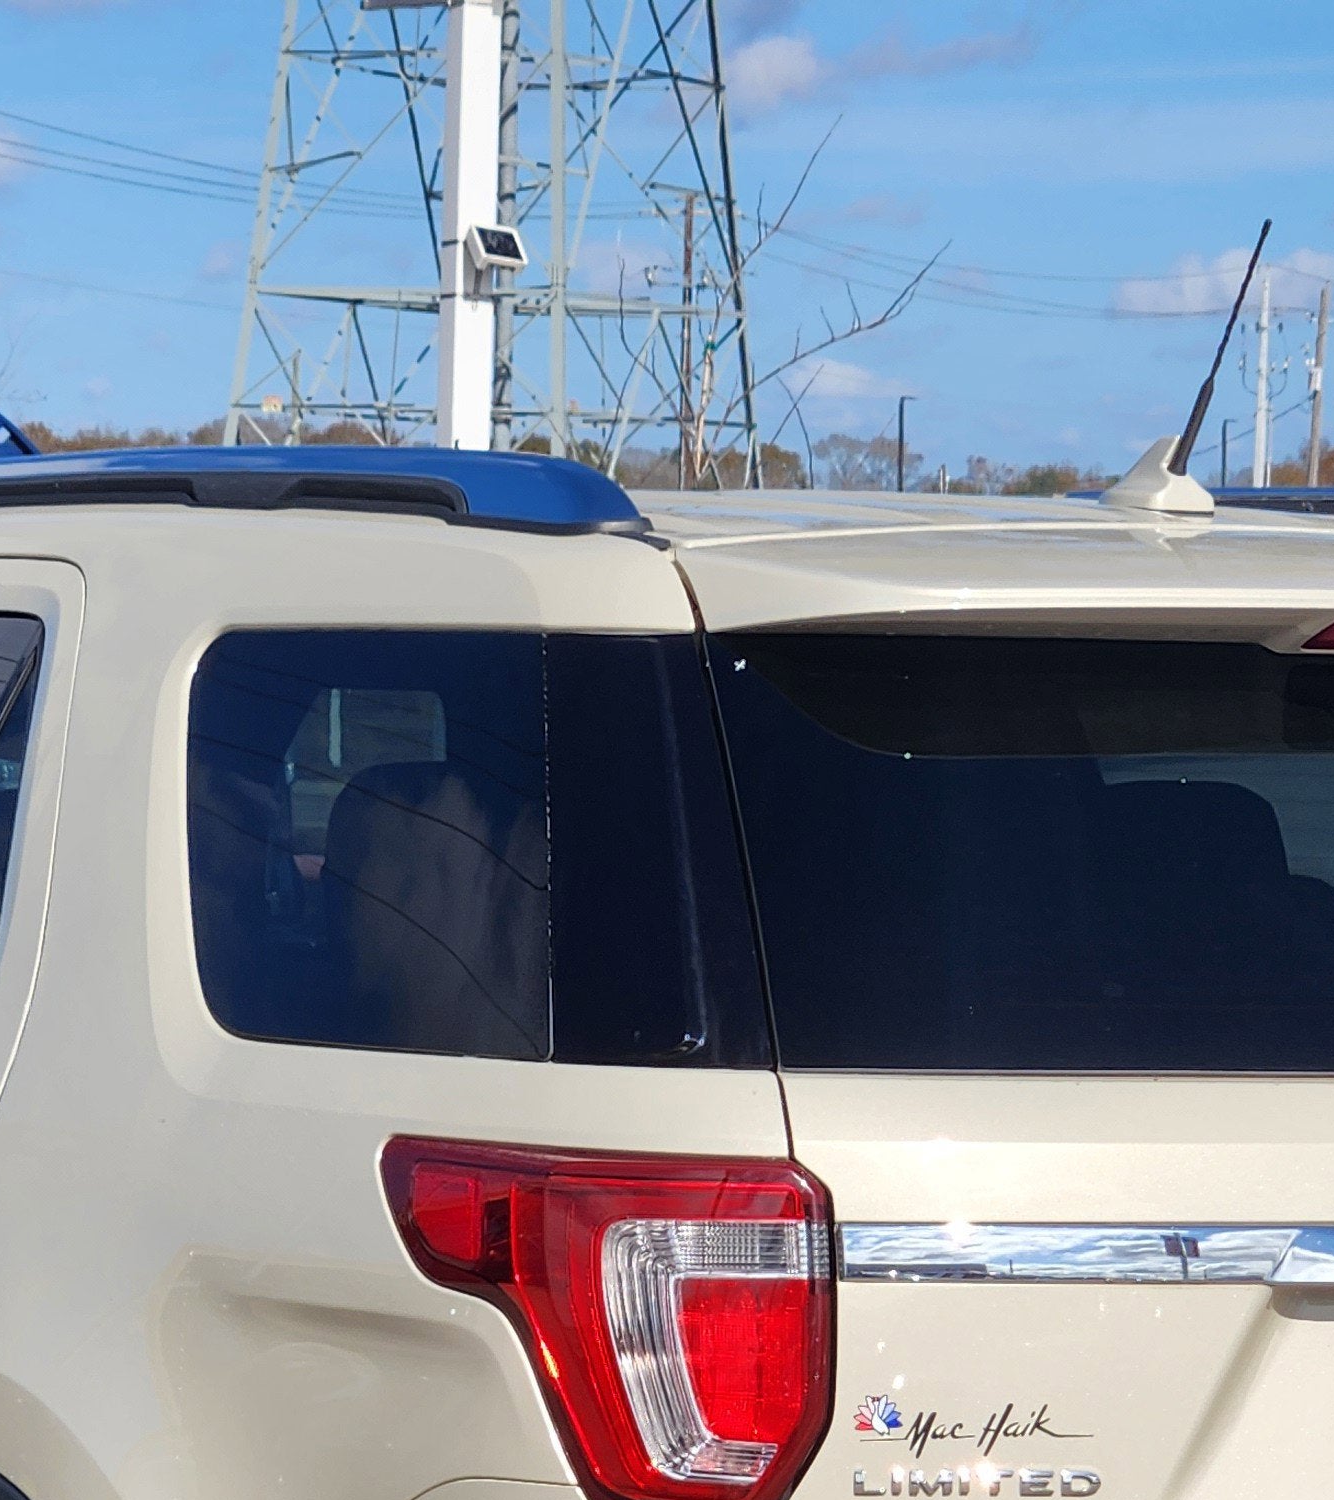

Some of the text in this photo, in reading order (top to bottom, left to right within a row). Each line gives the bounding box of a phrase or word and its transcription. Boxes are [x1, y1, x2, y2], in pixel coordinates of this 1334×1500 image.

[892, 1403, 1072, 1459] Mac Haik
[853, 1468, 1102, 1497] LIMITED
